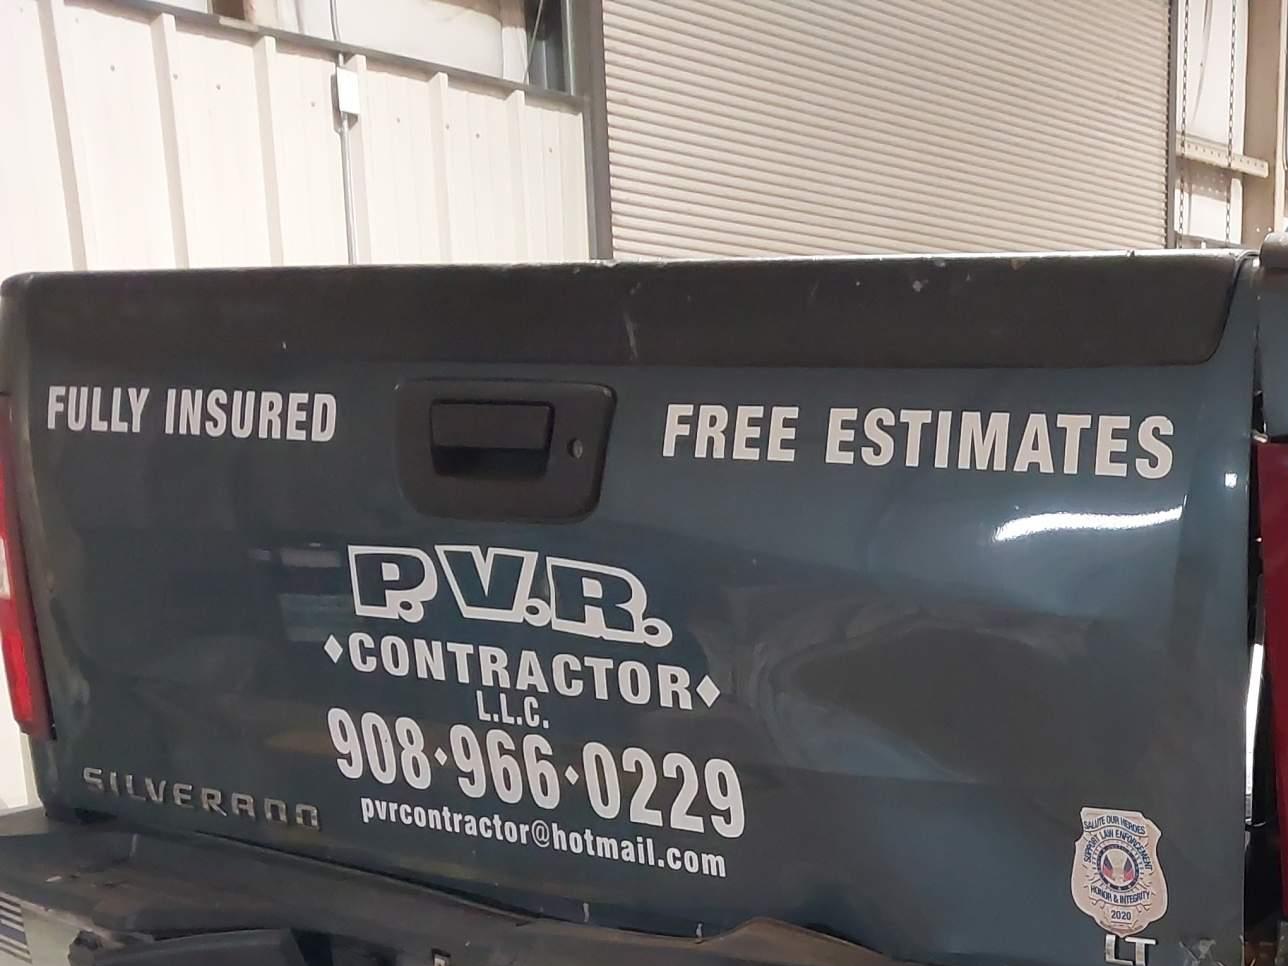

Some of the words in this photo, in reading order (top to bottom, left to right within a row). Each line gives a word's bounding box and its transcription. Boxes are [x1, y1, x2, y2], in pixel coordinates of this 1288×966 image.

[47, 385, 150, 433] FULLY
[164, 388, 338, 443] INSURED
[662, 403, 800, 462] FREE
[824, 407, 1175, 480] ESTIMATES
[347, 544, 673, 648] P.V.R.
[476, 690, 550, 729] L.L.C.
[360, 797, 727, 878] pvrcontractor@hotmail.com
[1083, 815, 1106, 830] SALUTE
[1106, 815, 1120, 826] OUR
[1120, 816, 1146, 835] HEROES
[1083, 834, 1102, 863] SUPPORT
[1101, 830, 1115, 840] LAW
[1115, 829, 1153, 871] ENFORCEMENT
[1090, 884, 1113, 902] HONOR
[1113, 893, 1119, 903] &
[1119, 889, 1151, 905] INTEGRITY
[1110, 909, 1132, 921] 2020
